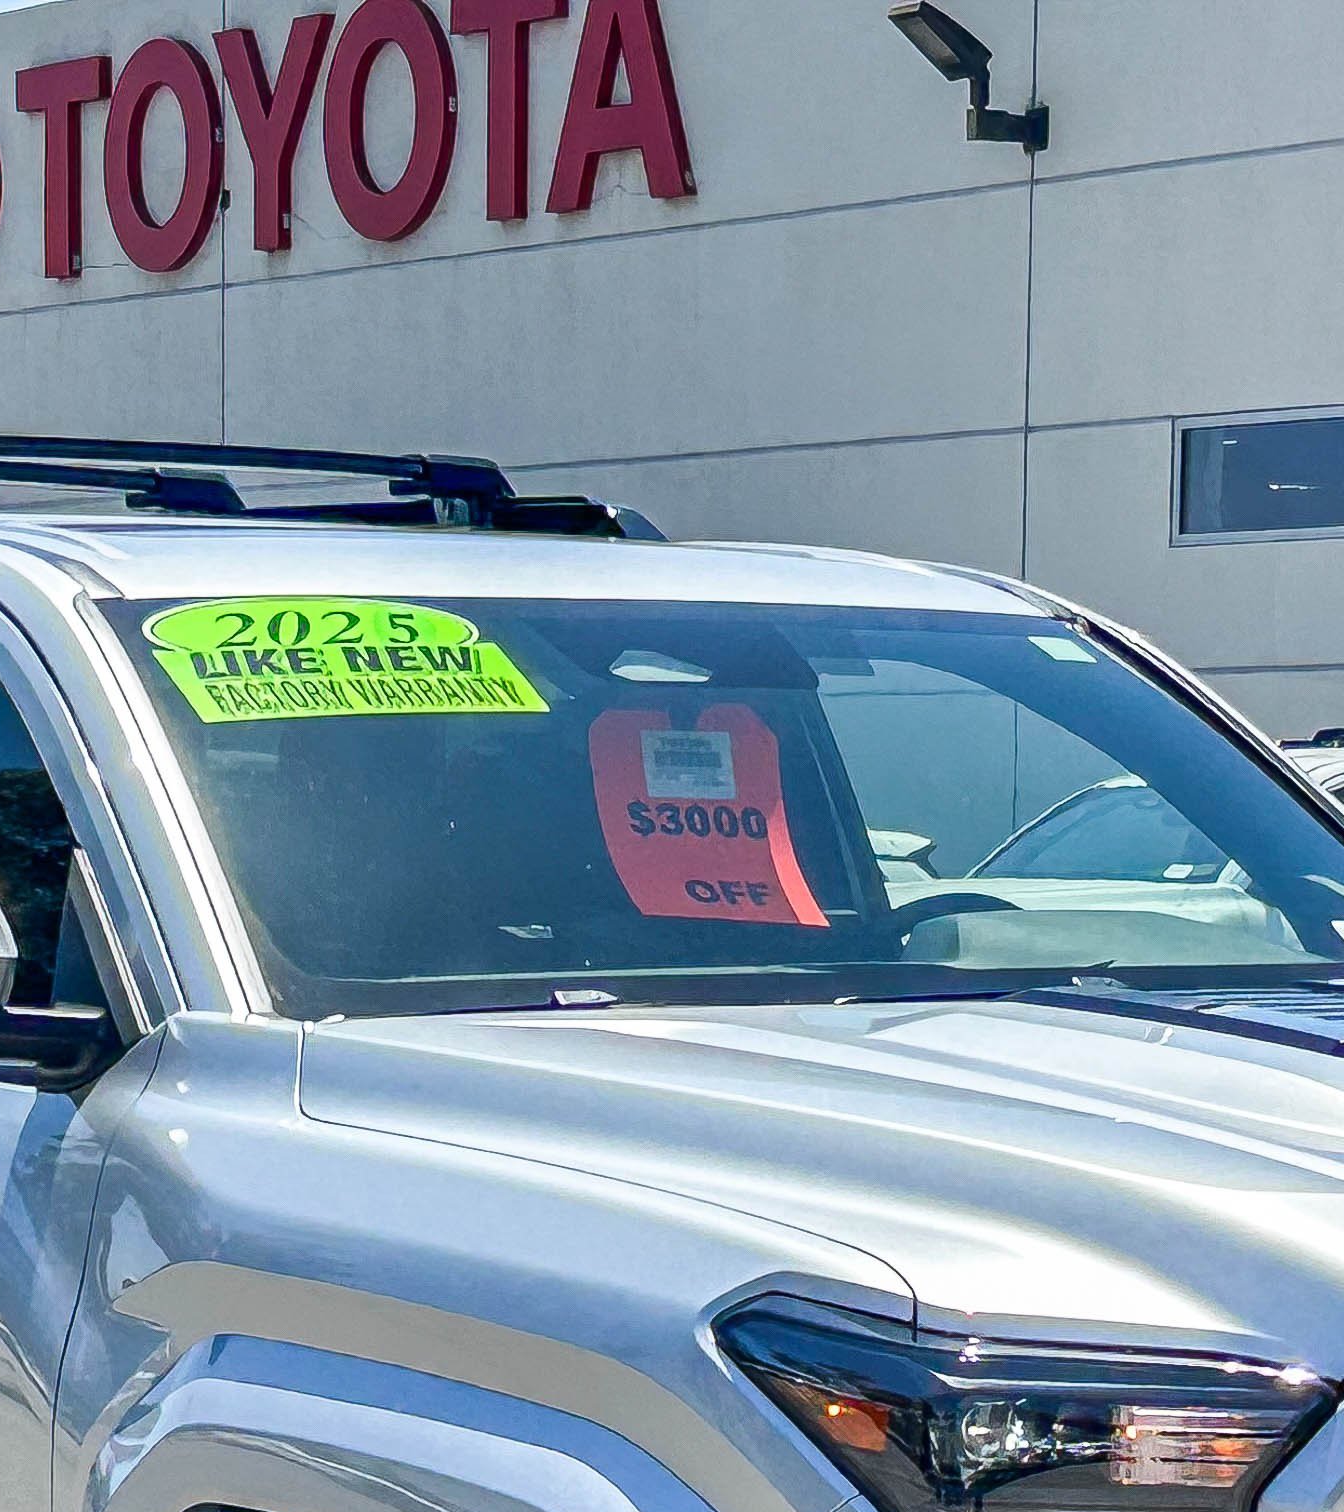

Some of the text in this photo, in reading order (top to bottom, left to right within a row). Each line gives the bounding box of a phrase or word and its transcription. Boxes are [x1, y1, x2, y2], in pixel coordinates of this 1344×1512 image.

[16, 0, 698, 279] TOYOTA
[214, 611, 420, 649] 2025
[189, 644, 478, 679] LIKE NEW
[205, 675, 523, 714] FACTORY WARRANTY
[626, 800, 769, 839] $3000
[684, 879, 770, 906] OFF
